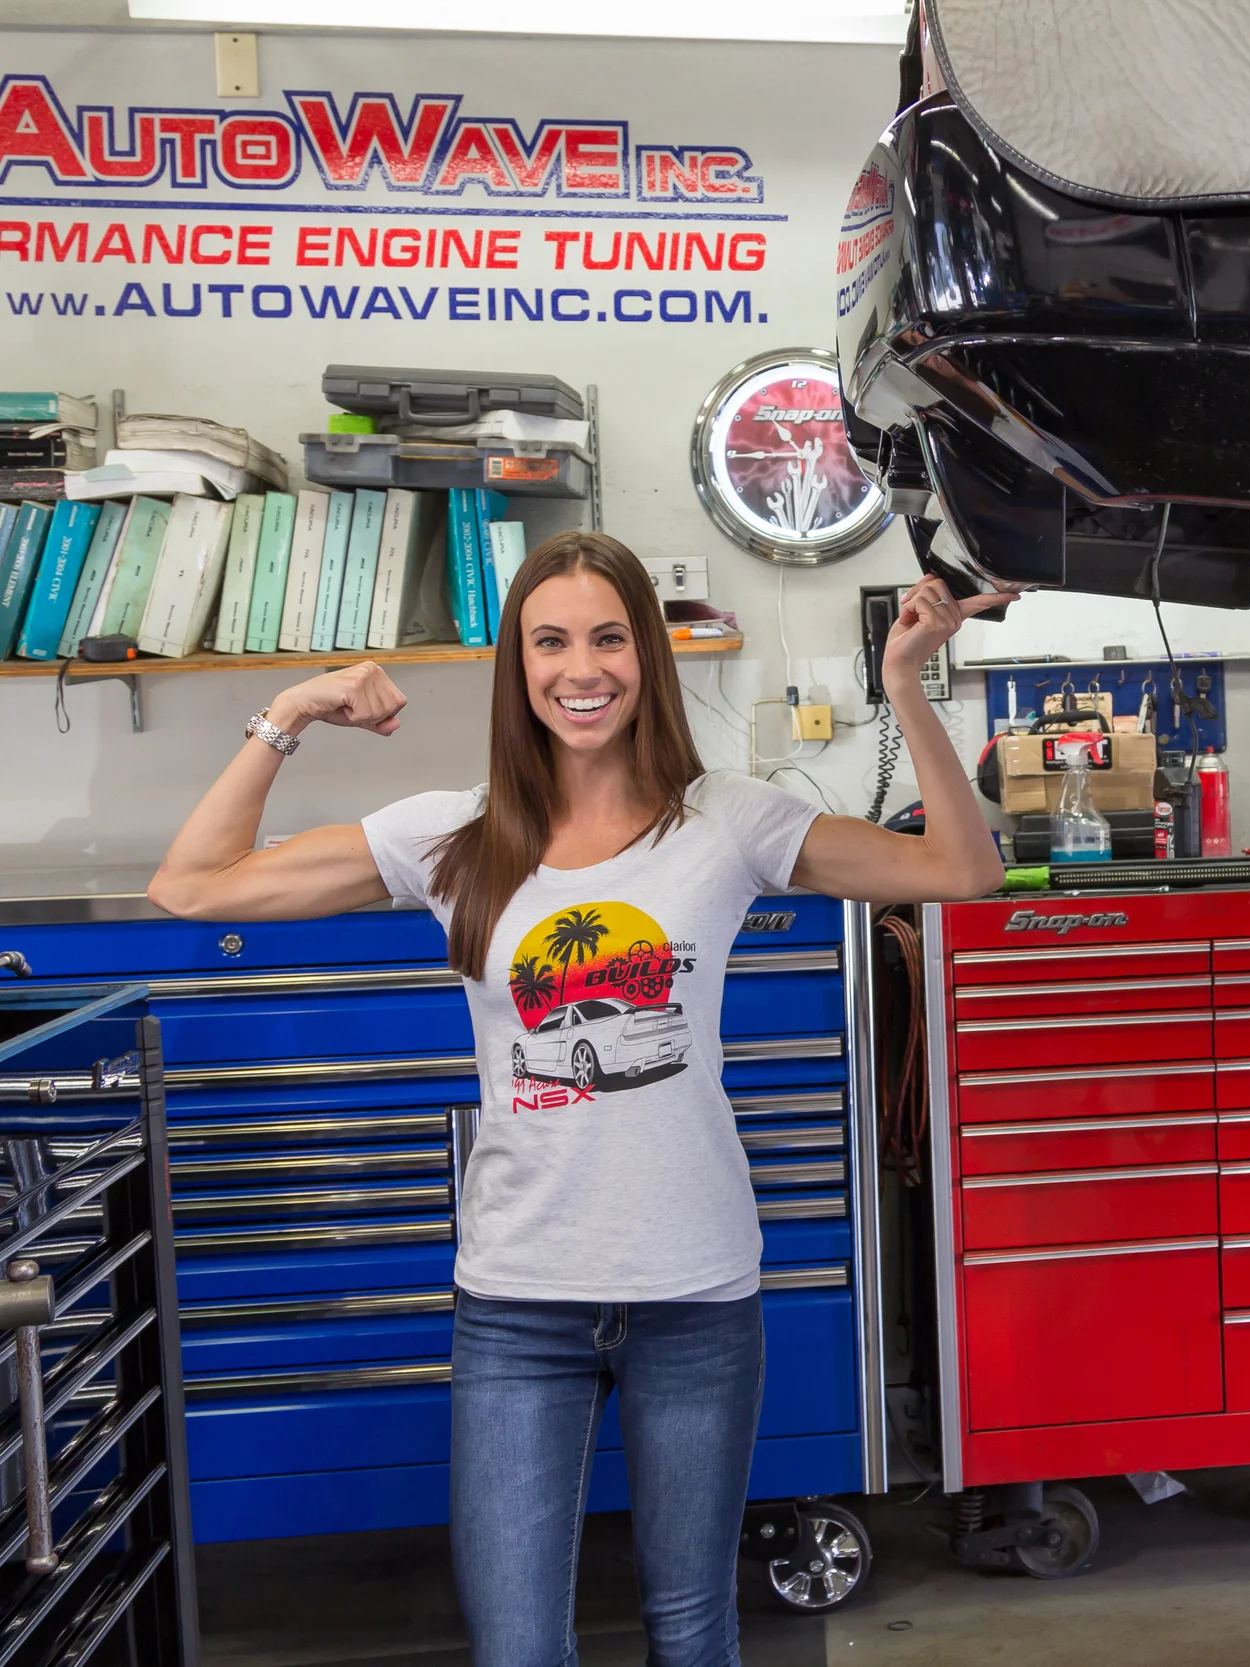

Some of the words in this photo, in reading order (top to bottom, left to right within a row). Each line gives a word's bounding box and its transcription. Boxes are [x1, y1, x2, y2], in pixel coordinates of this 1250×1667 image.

[636, 145, 763, 203] INC.
[295, 227, 520, 269] ENGINE
[544, 231, 766, 271] TUNING
[791, 380, 807, 388] 12
[462, 522, 472, 560] 2002-2004
[485, 541, 493, 565] CIVIC
[2, 571, 18, 607] ELEMENT
[48, 578, 61, 600] CIVIC
[466, 563, 474, 585] CIVIC
[468, 590, 478, 628] Hatchback
[1004, 910, 1128, 935] Snap-on
[663, 941, 696, 952] clarion
[584, 957, 697, 988] BUILDS
[513, 1084, 596, 1114] NSX
